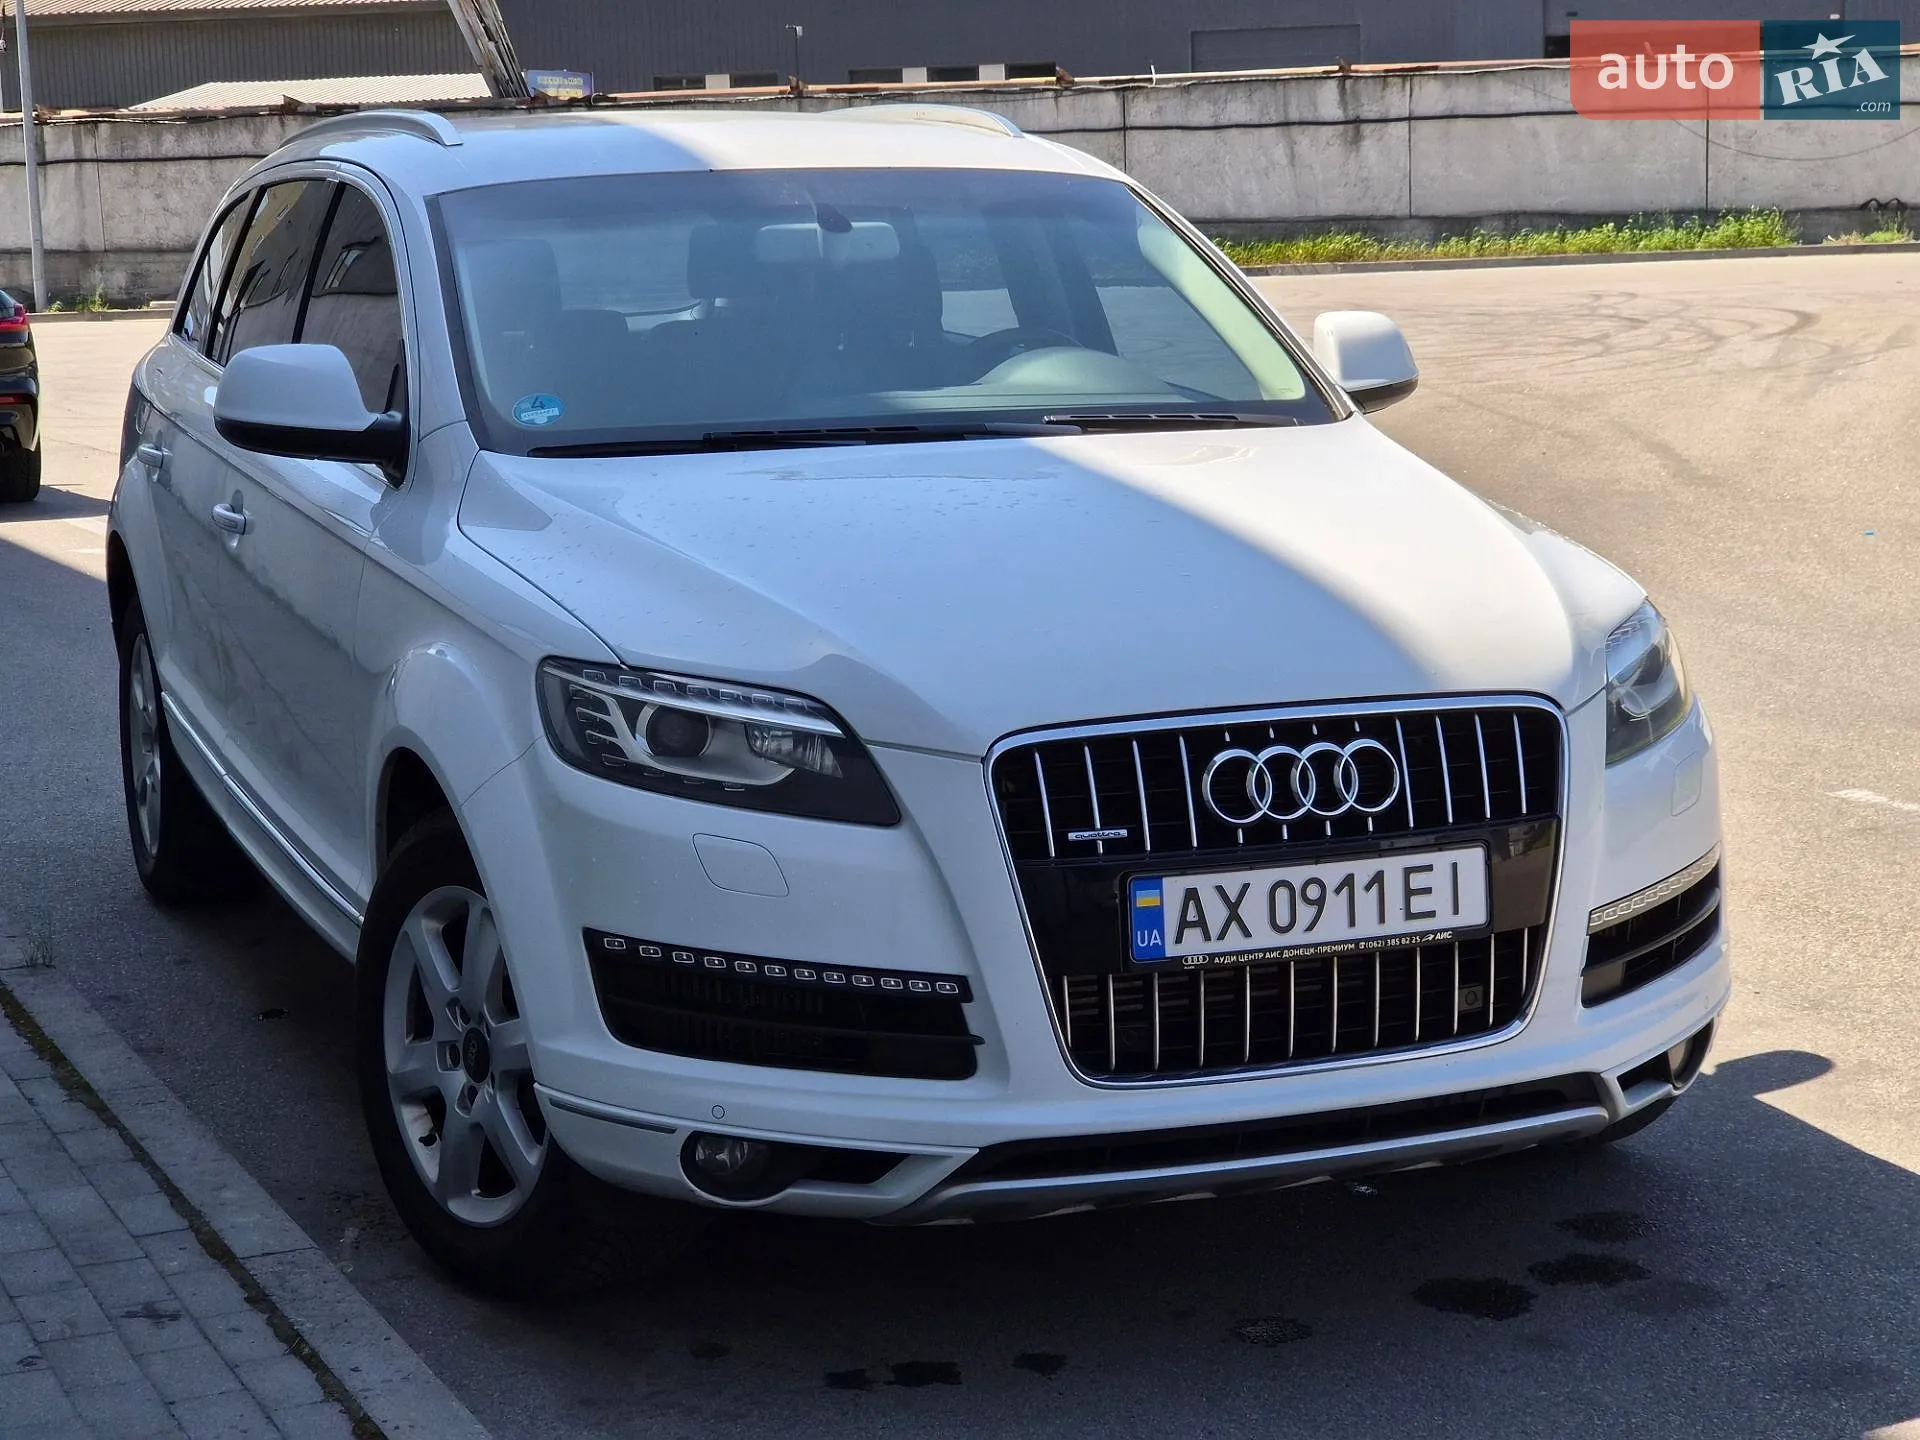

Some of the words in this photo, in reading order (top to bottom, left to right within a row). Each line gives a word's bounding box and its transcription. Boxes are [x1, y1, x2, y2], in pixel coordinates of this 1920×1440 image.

[1075, 831, 1121, 839] quattro
[1174, 881, 1253, 945] AX
[1268, 869, 1386, 935] 0911
[1403, 861, 1460, 922] EI
[1137, 928, 1162, 948] UA
[1435, 931, 1453, 941] АИС
[1213, 954, 1237, 965] АУДИ
[1238, 951, 1264, 963] ЦЕНТР
[1265, 949, 1281, 959] АИС
[1282, 942, 1355, 959] ДОНЕЦК-ПРЕМИУМ
